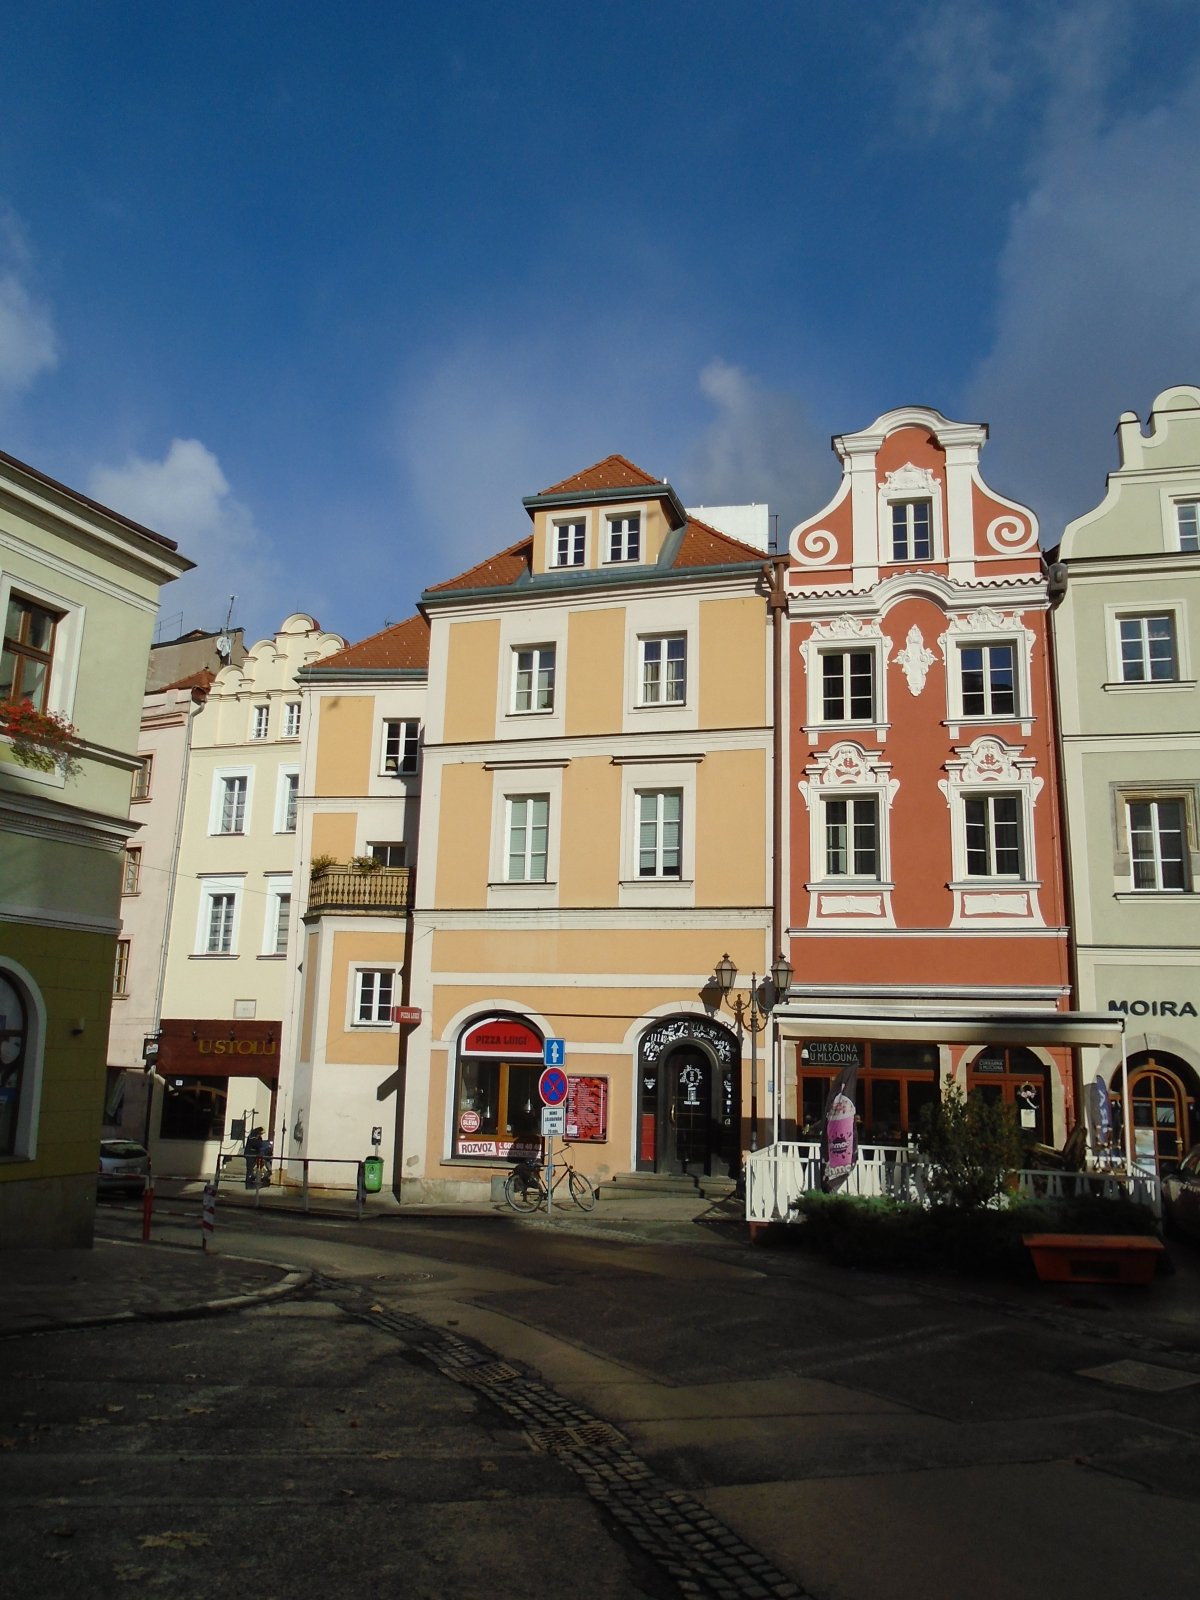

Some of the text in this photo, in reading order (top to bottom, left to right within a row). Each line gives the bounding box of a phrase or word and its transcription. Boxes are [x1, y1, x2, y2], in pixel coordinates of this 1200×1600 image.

[1108, 1000, 1198, 1017] MOIRA
[475, 1035, 527, 1045] PIZZA LUIGI
[199, 1040, 276, 1055] U STOLU
[810, 1042, 858, 1053] CUKRÁRNA
[810, 1052, 858, 1062] U MLSOUNA
[461, 1142, 493, 1154] ROZVOZ
